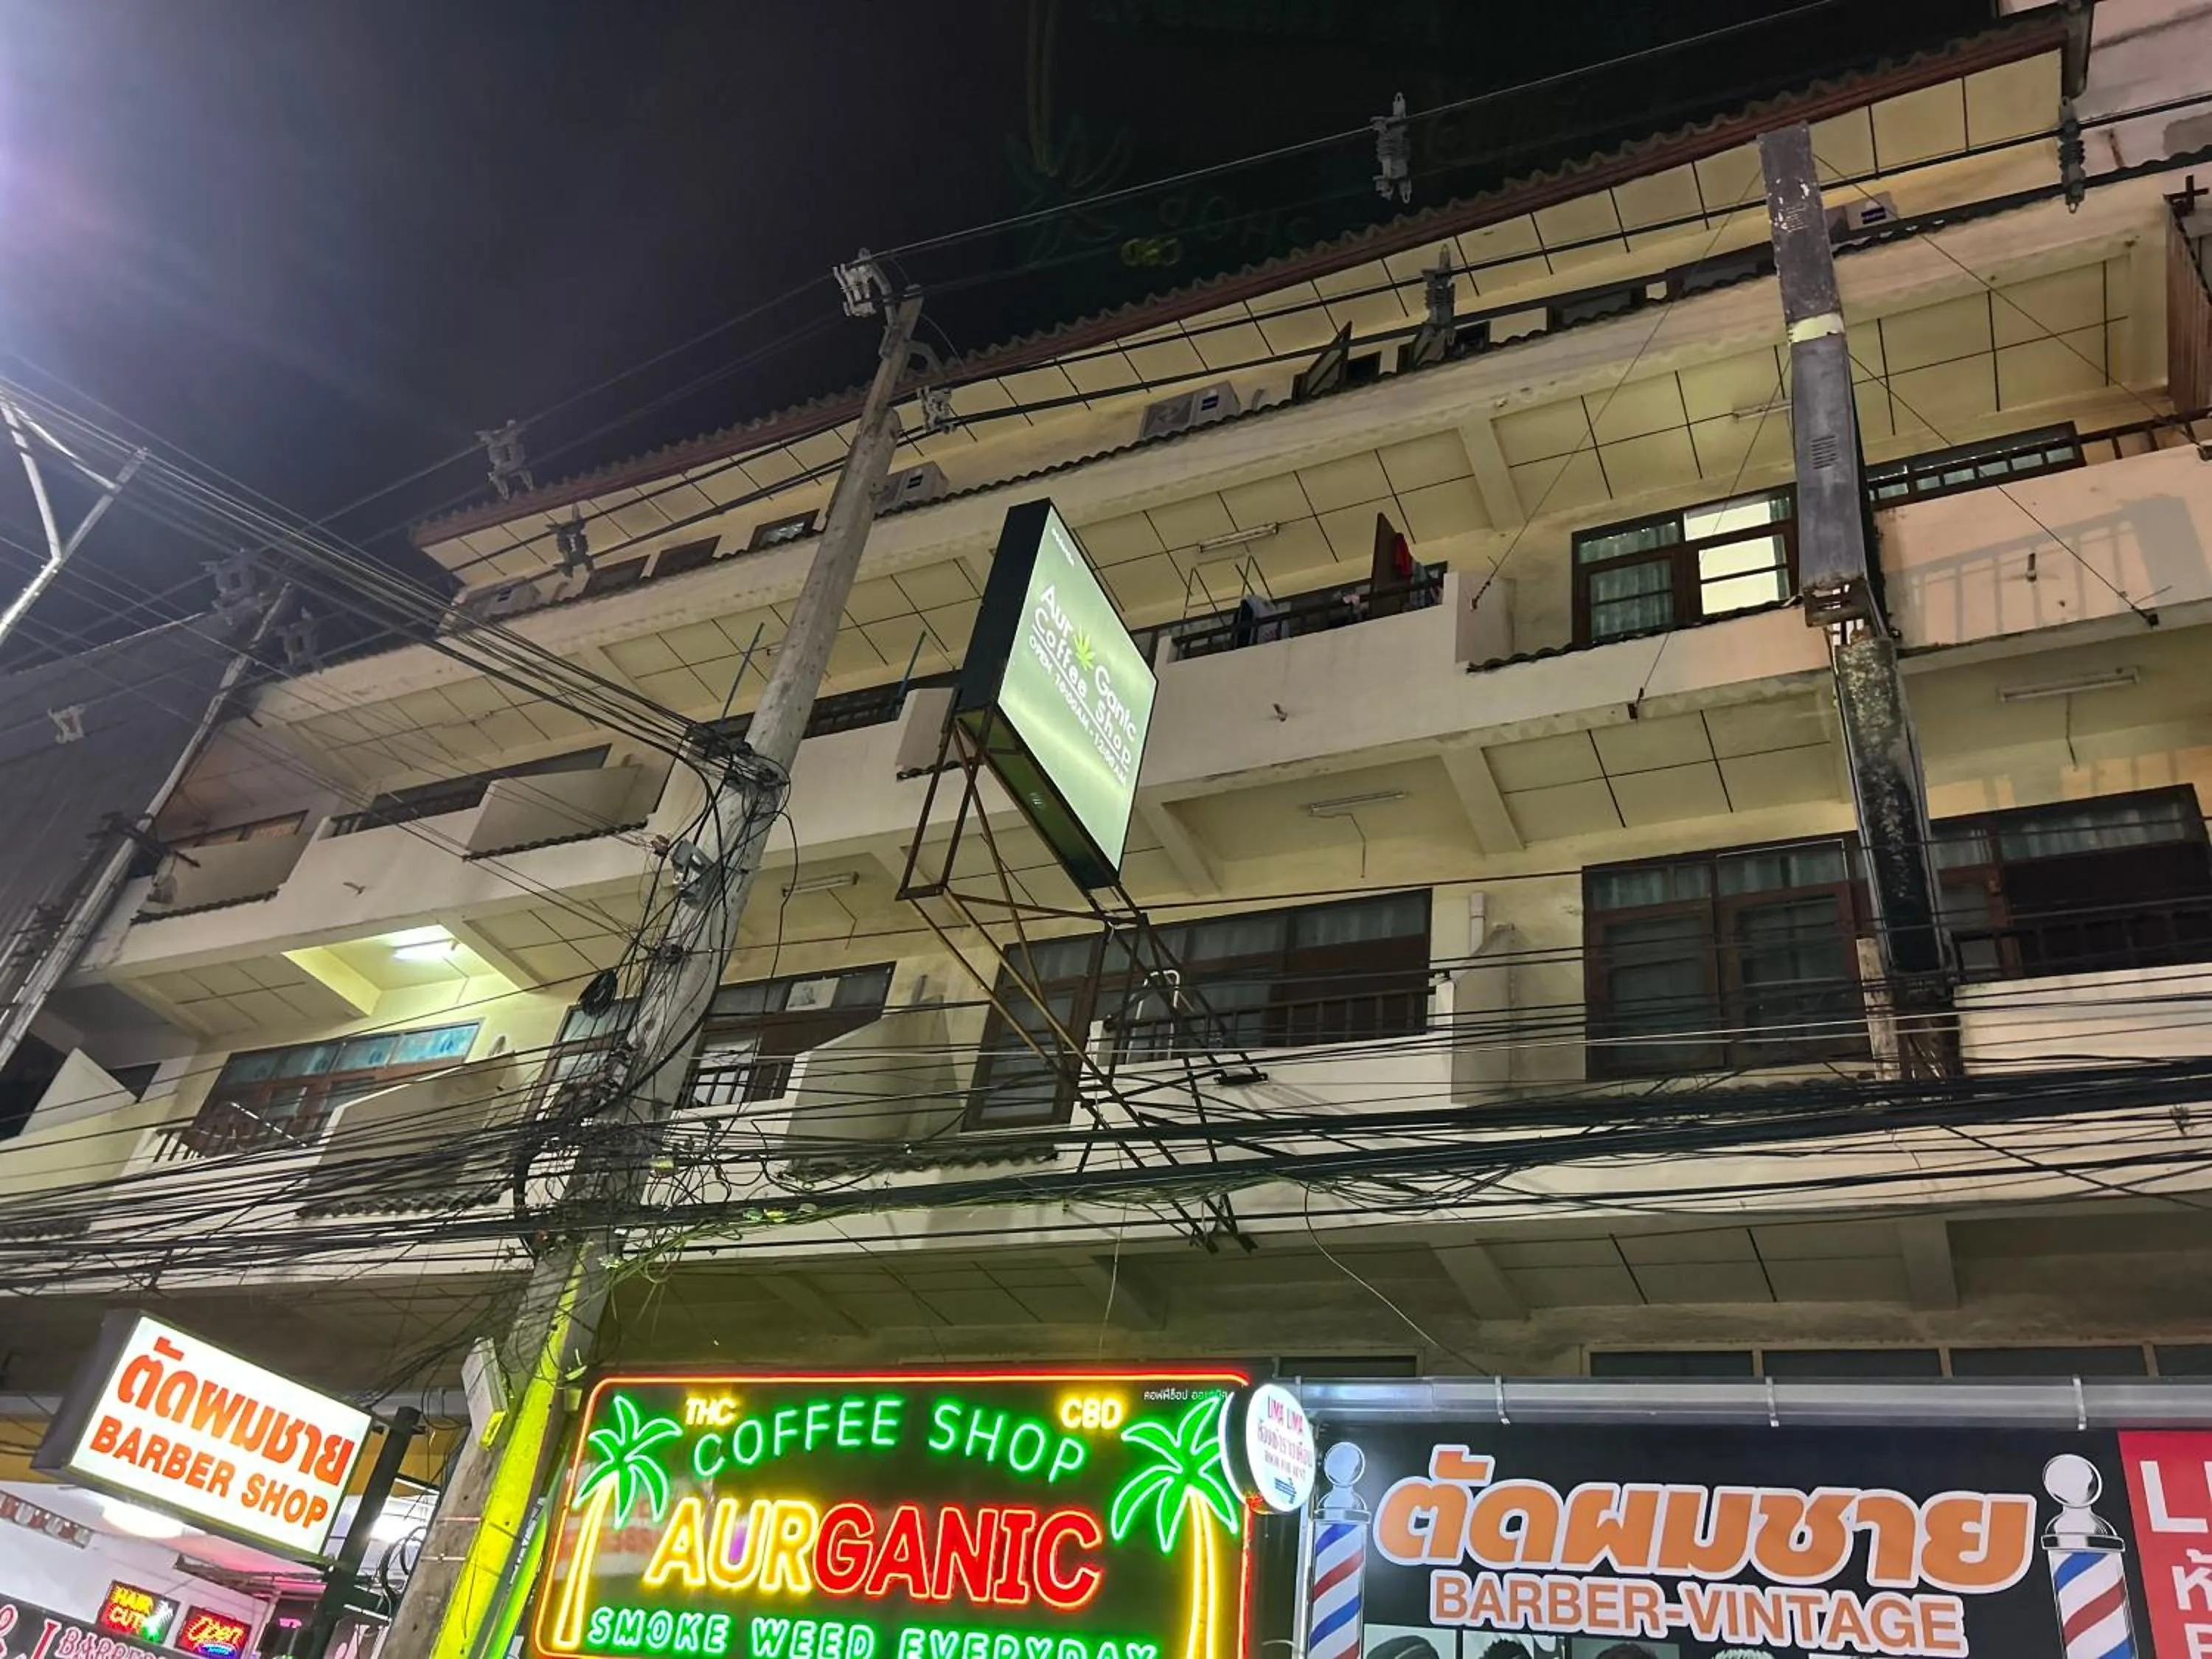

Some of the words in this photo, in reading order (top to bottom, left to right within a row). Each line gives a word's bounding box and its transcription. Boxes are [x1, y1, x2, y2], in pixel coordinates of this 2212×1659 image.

[1029, 635, 1052, 674] OPEN
[1034, 608, 1088, 698] Coffee
[1095, 700, 1131, 765] Shop
[1040, 585, 1074, 638] Aur
[1095, 666, 1136, 742] Ganic
[685, 1397, 737, 1427] THC
[693, 1399, 902, 1477] COFFEE
[929, 1402, 1086, 1483] SHOP
[1060, 1399, 1124, 1429] CBD
[89, 1415, 236, 1498] BARBER
[241, 1471, 328, 1529] SHOP
[643, 1497, 1102, 1609] AURGANIC
[1373, 1444, 2037, 1594] ตัดผมชาย
[110, 1605, 145, 1634] CUT
[112, 1586, 153, 1615] HAIR
[188, 1615, 244, 1644] Open
[588, 1607, 729, 1653] SMOKE
[751, 1617, 874, 1659] WEED
[1430, 1568, 1969, 1658] BARBER-VINTAGE
